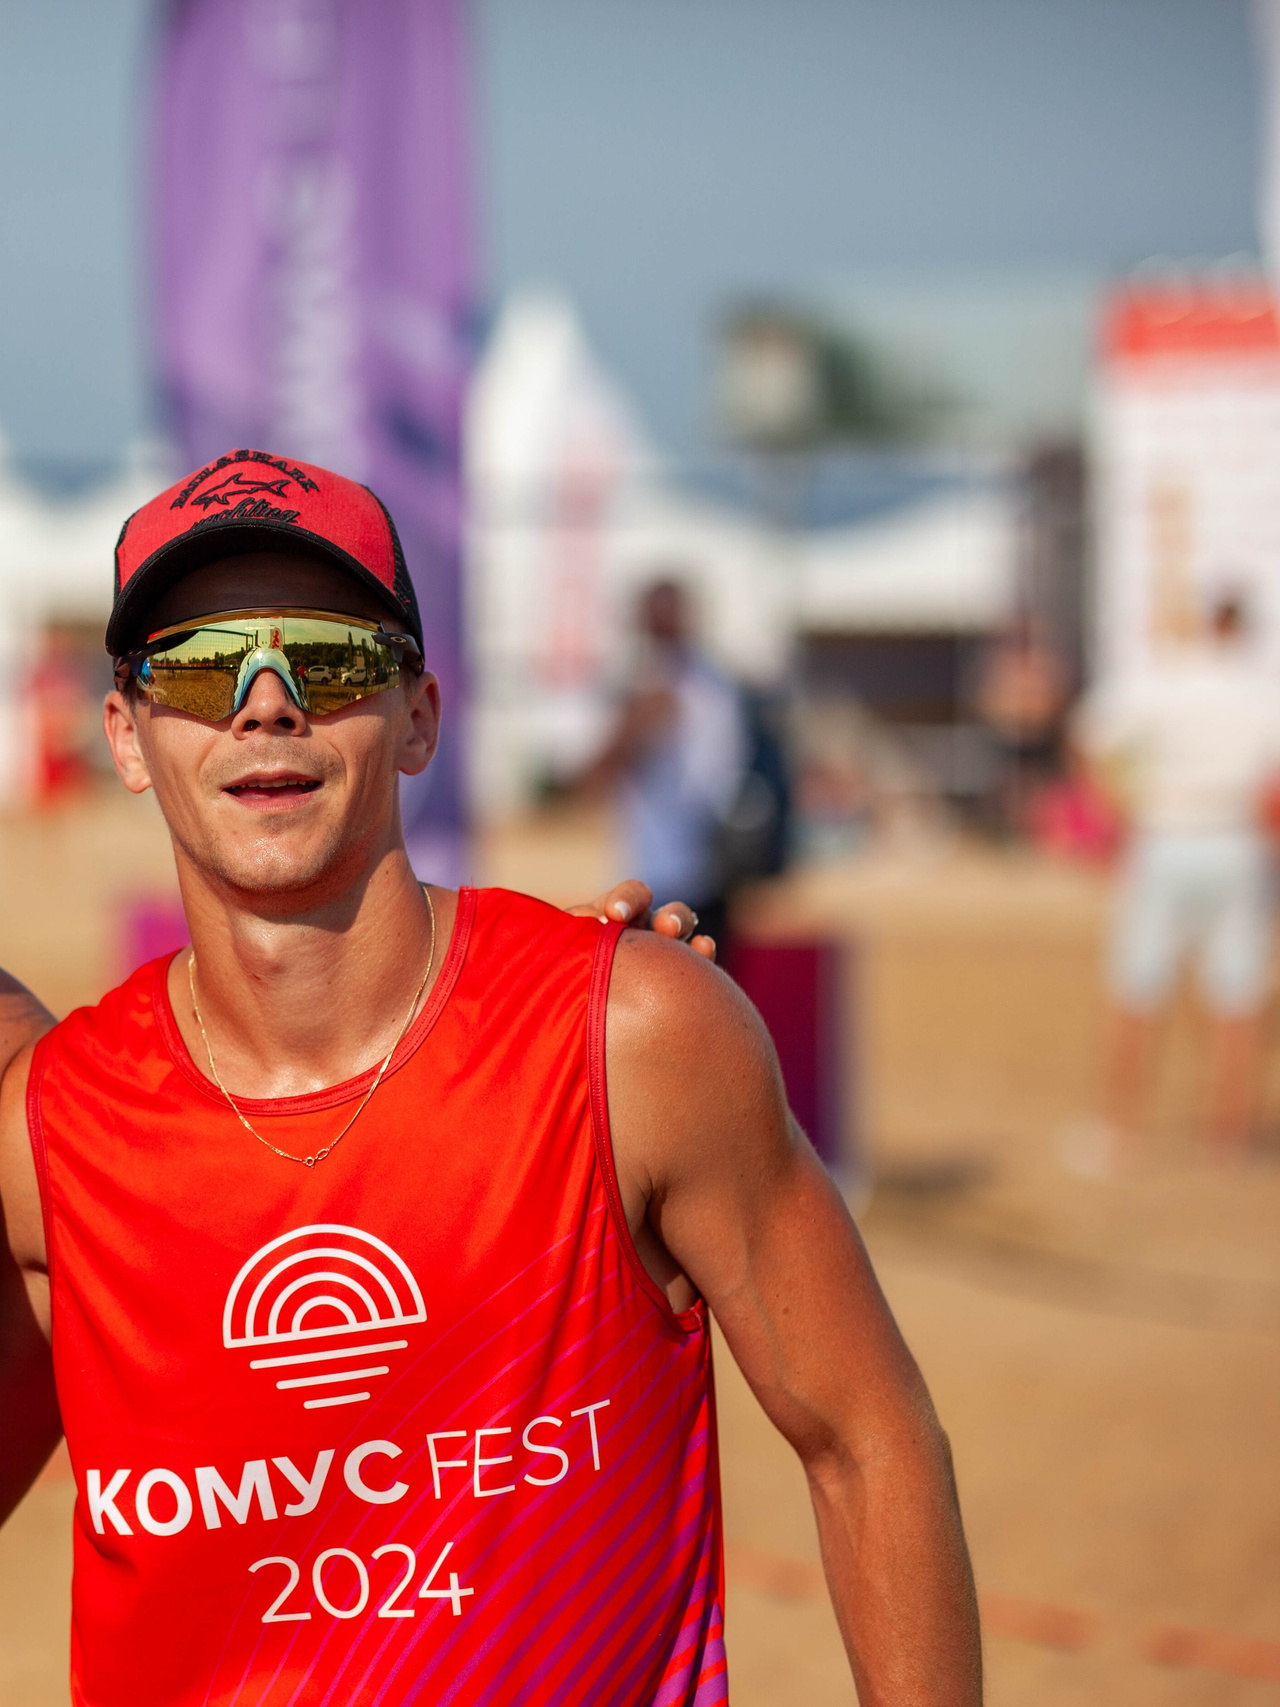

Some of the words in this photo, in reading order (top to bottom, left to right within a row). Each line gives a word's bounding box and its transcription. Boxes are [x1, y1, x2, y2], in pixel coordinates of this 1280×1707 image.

[85, 1439, 410, 1537] КОМУС
[426, 1399, 611, 1499] FEST
[247, 1541, 475, 1624] 2024
